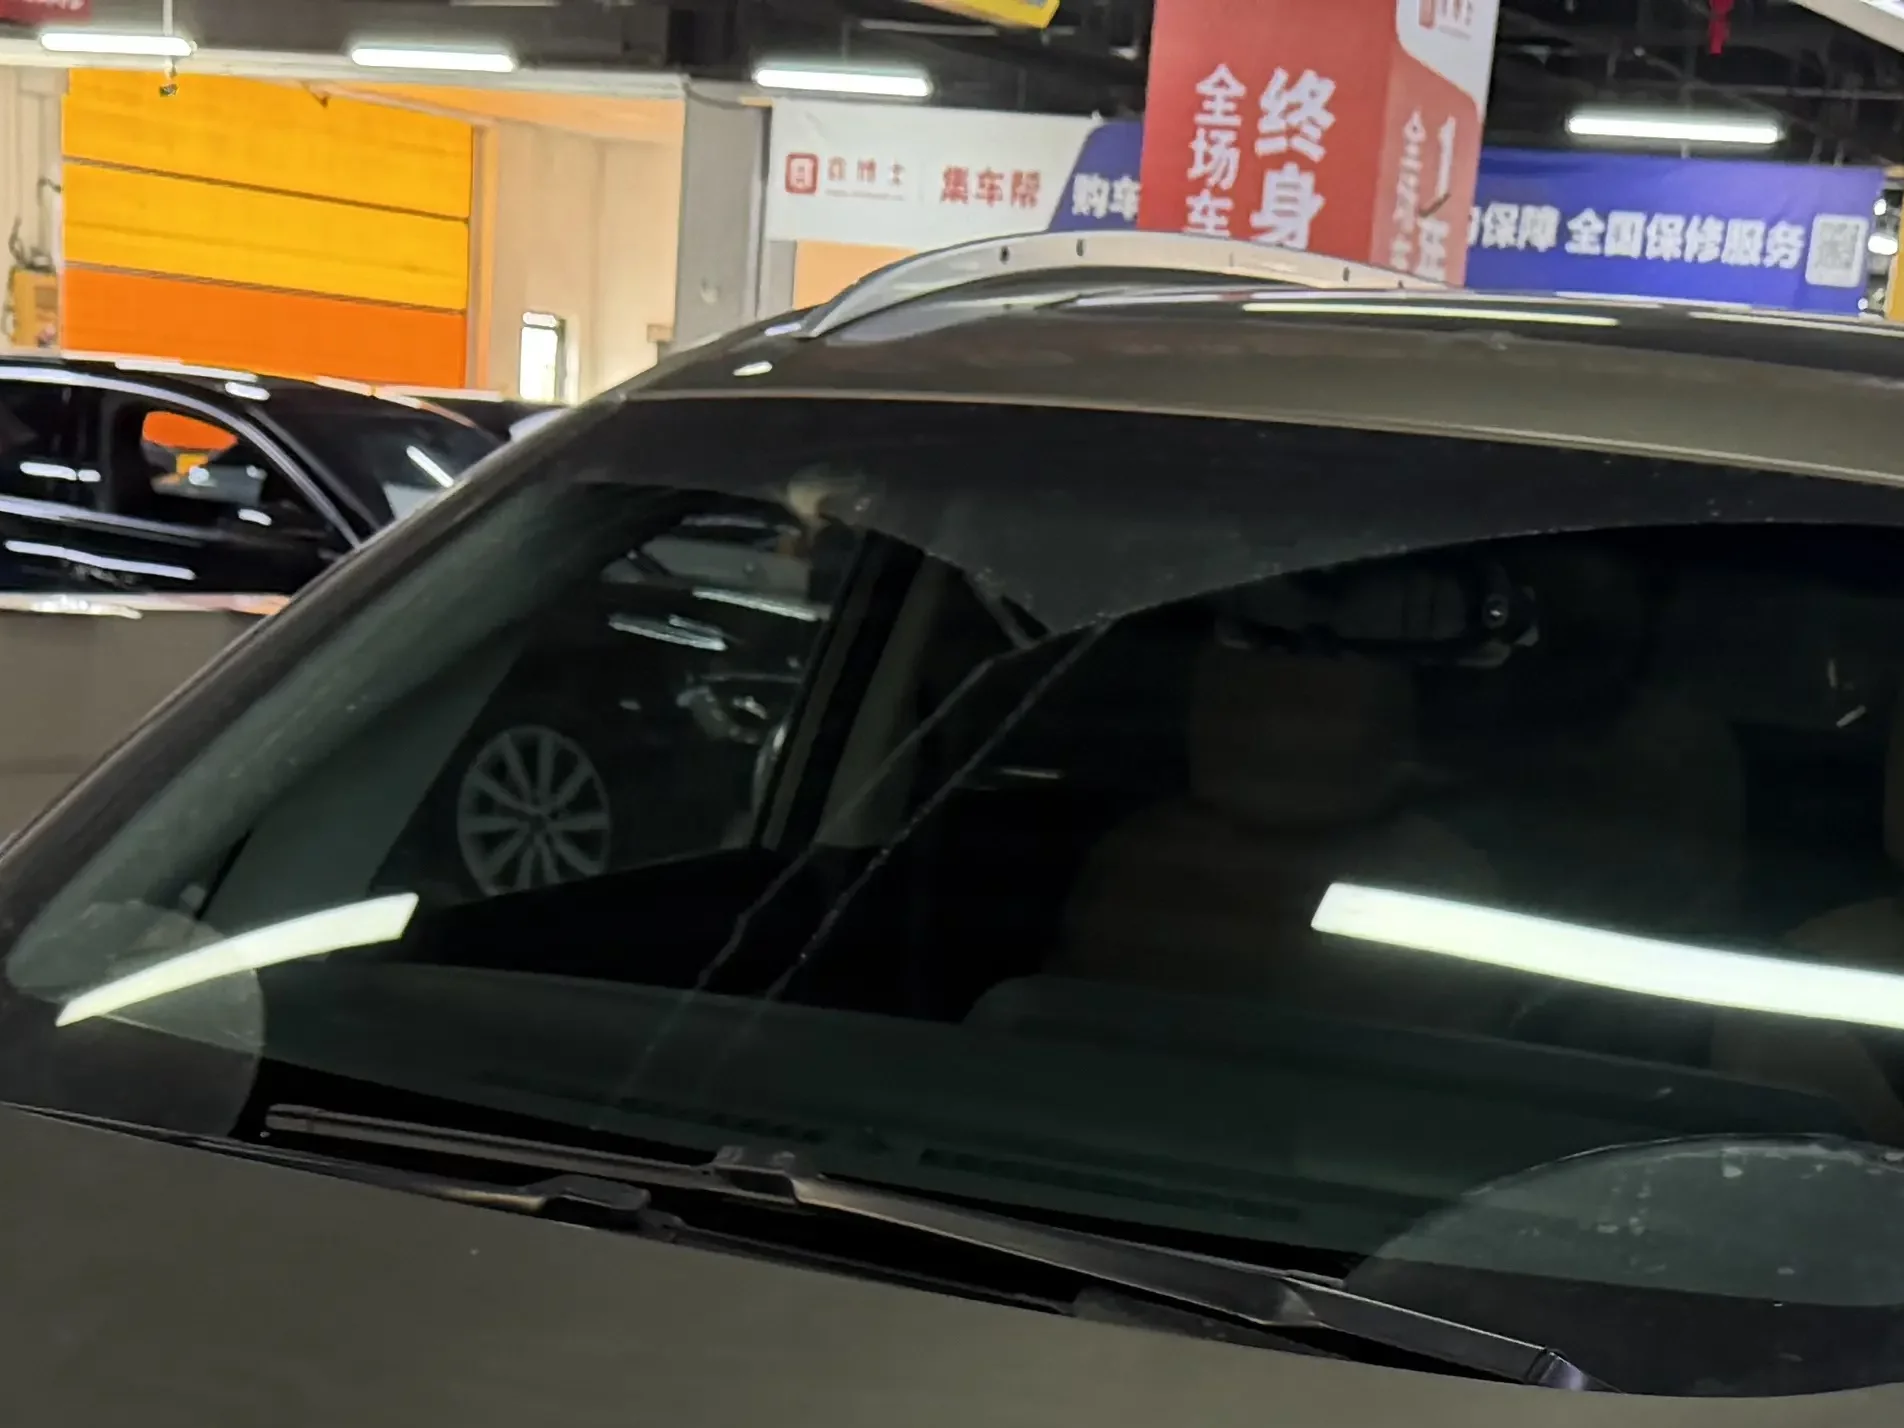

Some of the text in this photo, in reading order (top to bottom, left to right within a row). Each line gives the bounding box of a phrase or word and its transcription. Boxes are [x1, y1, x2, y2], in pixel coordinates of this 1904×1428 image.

[1565, 208, 1805, 269] 全国保修服务
